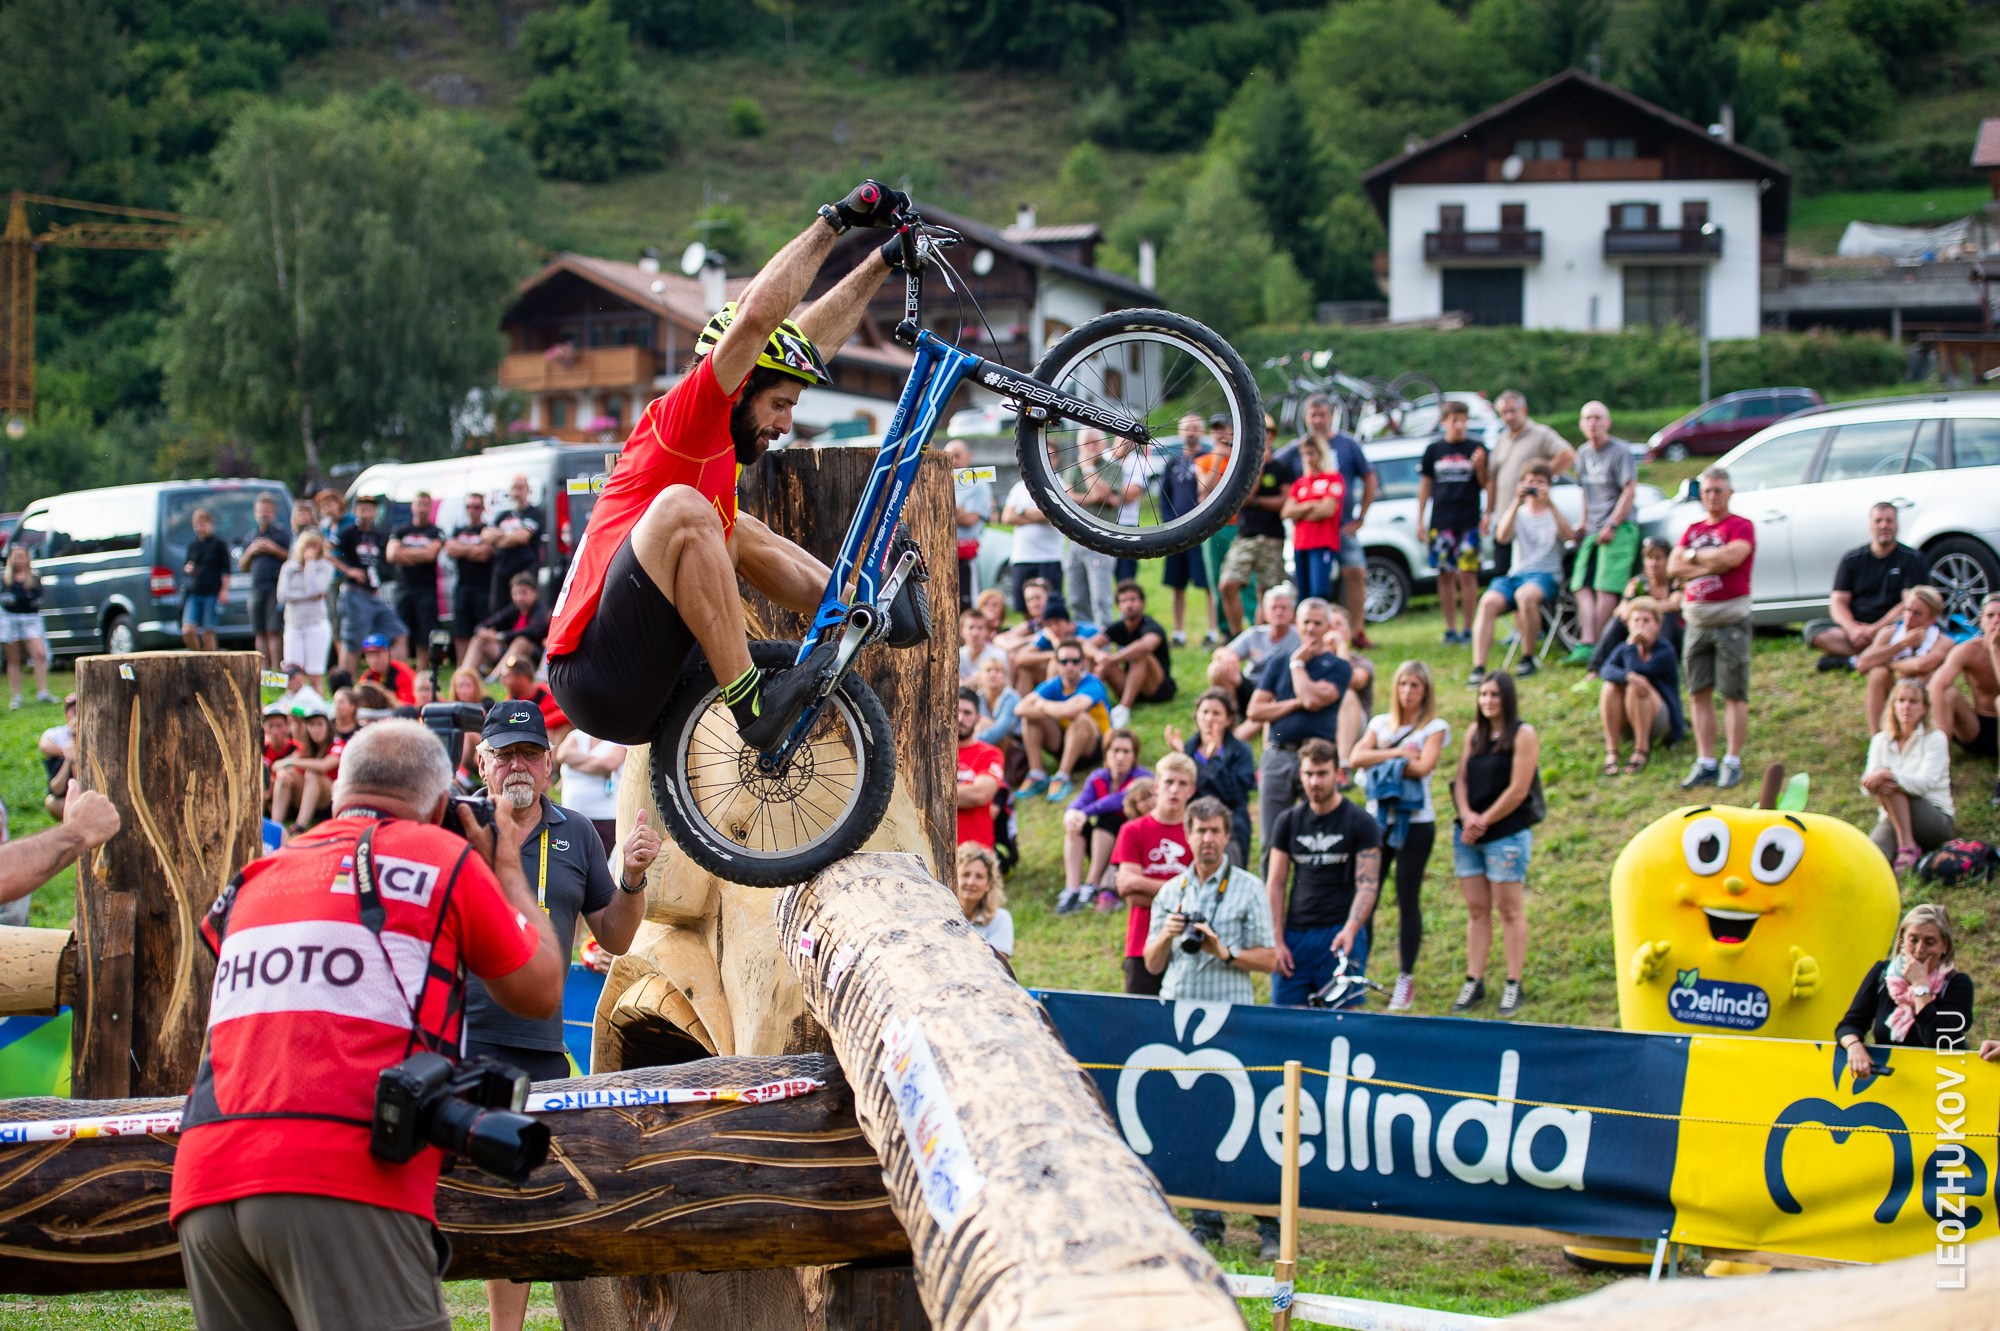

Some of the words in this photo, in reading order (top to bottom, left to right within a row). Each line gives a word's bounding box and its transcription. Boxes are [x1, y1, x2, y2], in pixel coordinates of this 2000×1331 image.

[889, 407, 905, 436] OPEN
[356, 842, 372, 893] Canon
[216, 945, 364, 999] PHOTO
[1670, 987, 1768, 1018] Melinda
[1116, 1034, 1593, 1192] Melinda
[1764, 1096, 2000, 1230] Me
